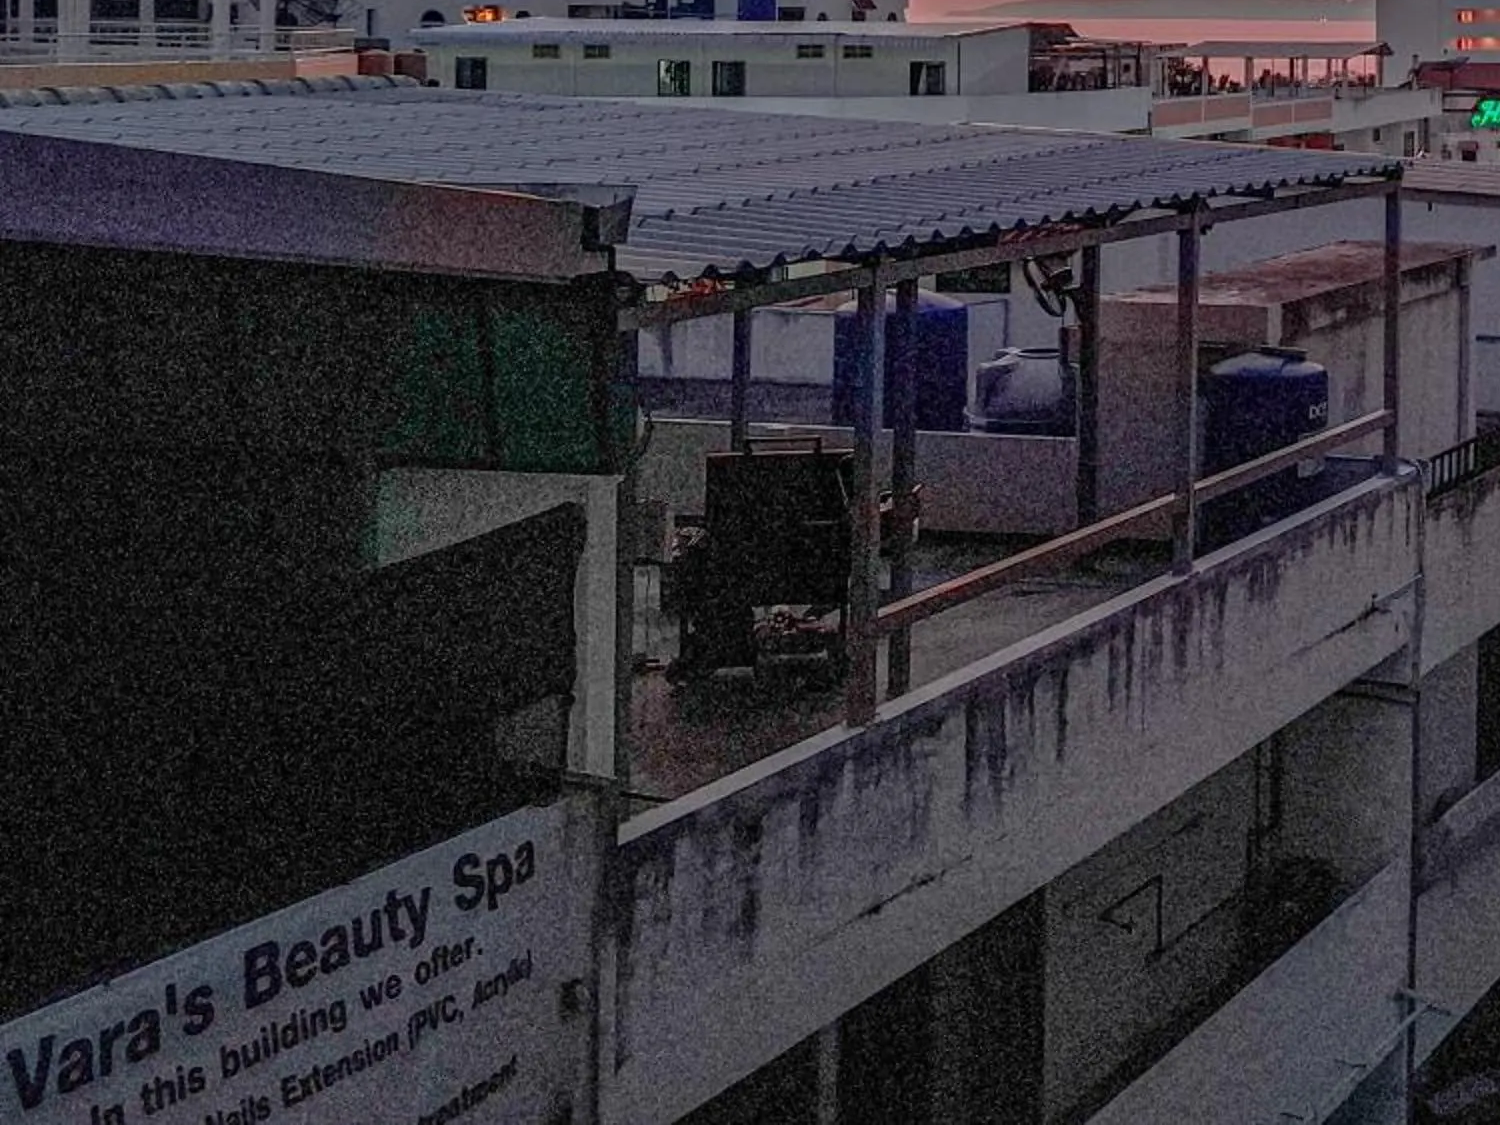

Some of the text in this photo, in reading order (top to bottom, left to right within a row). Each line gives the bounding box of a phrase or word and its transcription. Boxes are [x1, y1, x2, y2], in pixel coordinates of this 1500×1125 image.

[6, 840, 536, 1111] Vara's Beauty Spa
[141, 1065, 205, 1115] this
[219, 997, 347, 1078] building
[360, 974, 401, 1011] we
[205, 1096, 271, 1125] Nails
[281, 1032, 398, 1107] Extension
